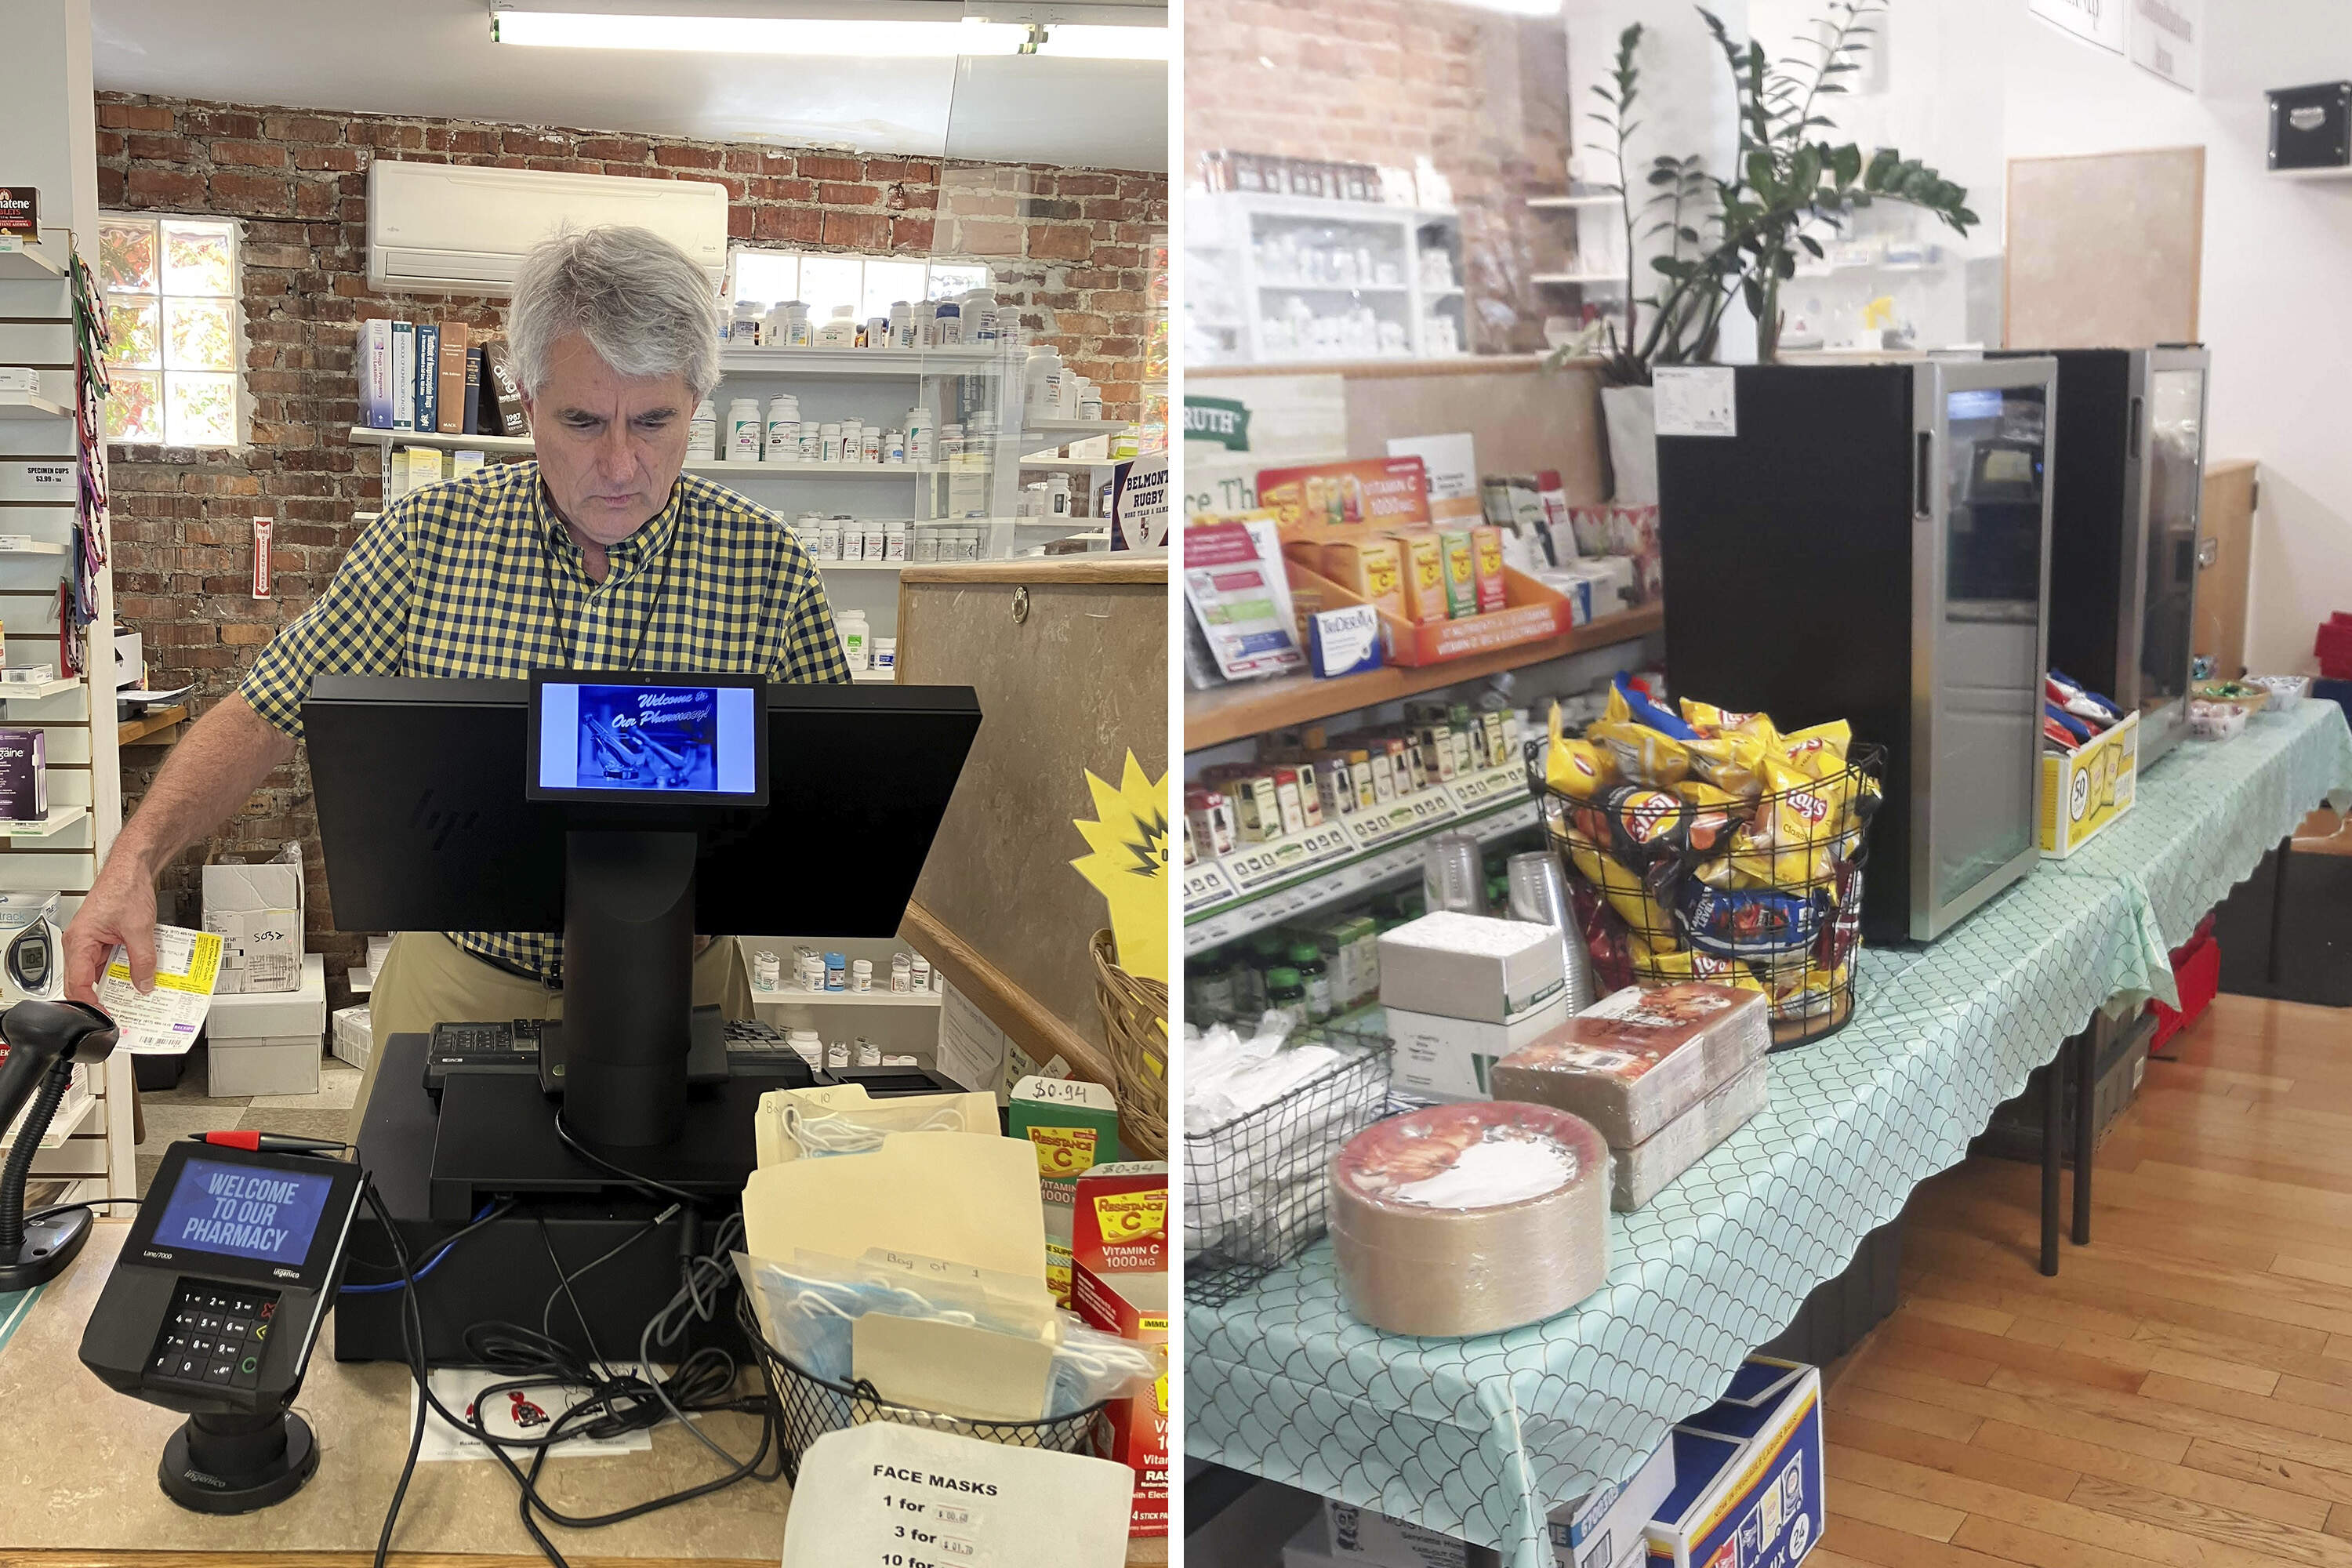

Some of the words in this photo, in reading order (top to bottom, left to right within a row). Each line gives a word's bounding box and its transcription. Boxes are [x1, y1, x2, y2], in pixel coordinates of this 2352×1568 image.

[493, 365, 517, 394] drug
[505, 412, 521, 423] 1987
[1127, 470, 1168, 492] BELMONT
[1134, 489, 1164, 508] RUGBY
[637, 693, 693, 709] Welcome
[611, 713, 637, 728] Our
[1786, 789, 1829, 822] Lay's
[1032, 1080, 1087, 1103] $0.94
[1053, 1148, 1073, 1167] C
[1102, 1163, 1155, 1174] $0.94
[208, 1173, 299, 1205] WELCOME
[212, 1197, 237, 1221] TO
[238, 1200, 278, 1226] OUR
[1121, 1211, 1142, 1230] C
[182, 1217, 289, 1253] PHARMACY
[1102, 1247, 1147, 1256] VITAMIN
[1150, 1244, 1160, 1254] C
[887, 1253, 913, 1270] Bag
[1106, 1257, 1138, 1268] 1000
[1138, 1258, 1156, 1267] MG
[273, 1268, 300, 1279] ingenico
[184, 1294, 190, 1302] 1
[209, 1298, 216, 1306] 2
[235, 1301, 241, 1310] 3
[176, 1314, 182, 1323] 4
[201, 1318, 208, 1327] 5
[227, 1322, 234, 1331] 6
[167, 1336, 174, 1345] 7
[193, 1340, 200, 1349] 8
[219, 1344, 226, 1353] 9
[873, 1465, 923, 1483] FACE
[928, 1475, 998, 1497] MASKS
[884, 1495, 891, 1507] 1
[899, 1498, 925, 1512] for
[1132, 1510, 1138, 1520] 4
[895, 1525, 905, 1537] 3
[911, 1529, 937, 1543] for
[1793, 1523, 1805, 1551] 24
[882, 1553, 902, 1566] 10
[908, 1557, 935, 1568] for
